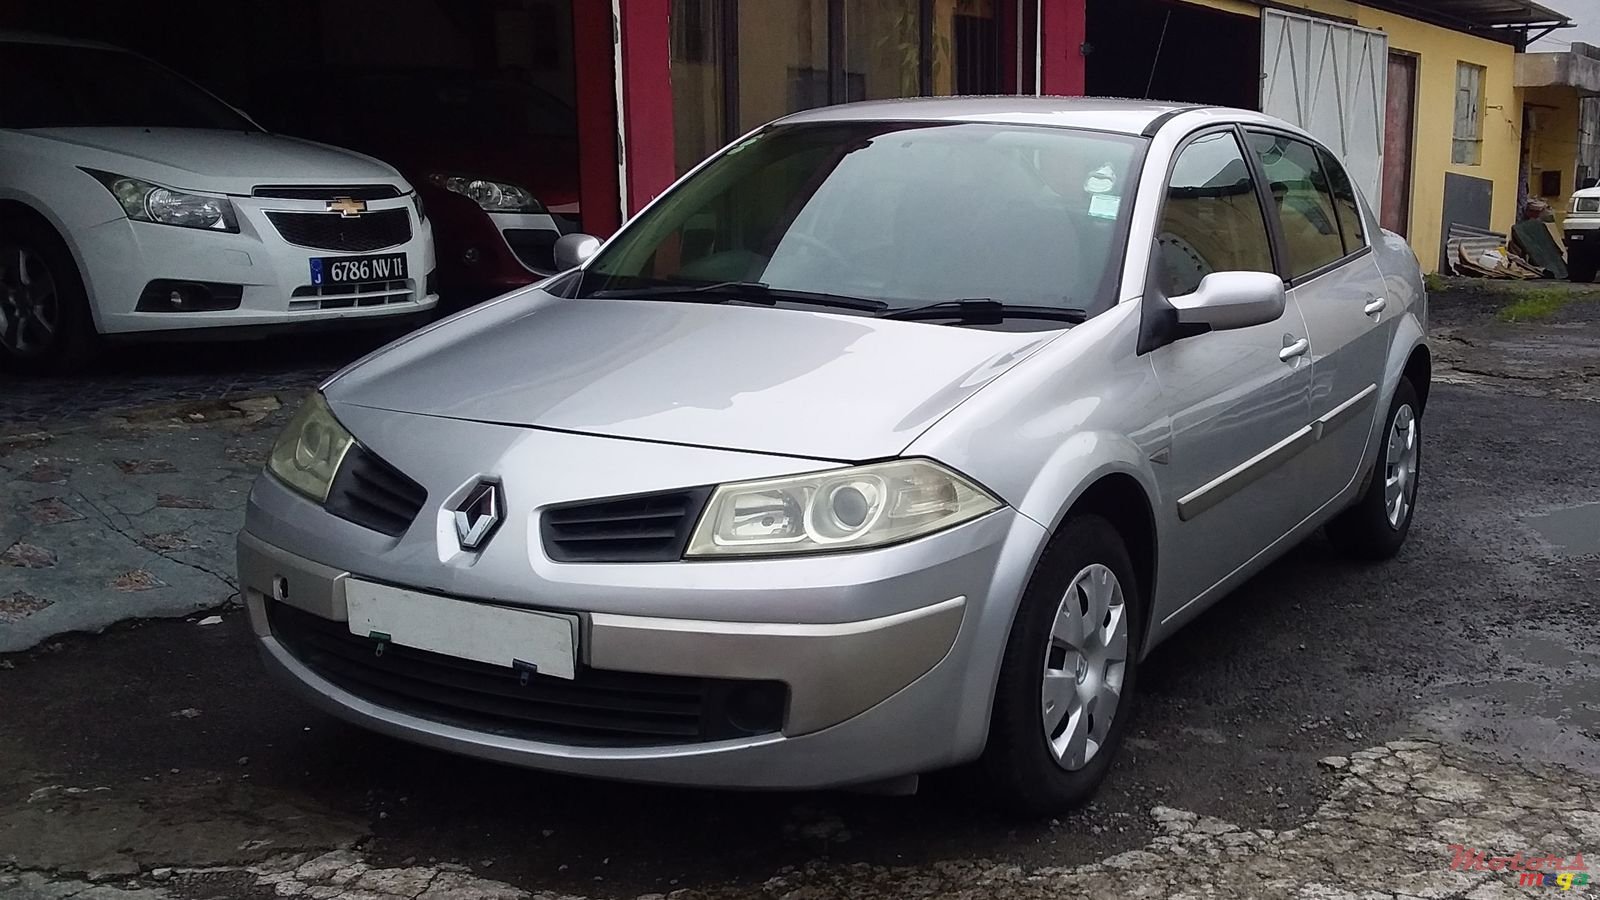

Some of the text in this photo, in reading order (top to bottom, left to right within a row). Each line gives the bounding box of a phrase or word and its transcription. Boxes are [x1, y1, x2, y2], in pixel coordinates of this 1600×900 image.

[314, 273, 322, 284] J
[331, 257, 403, 282] 6786 NV 11
